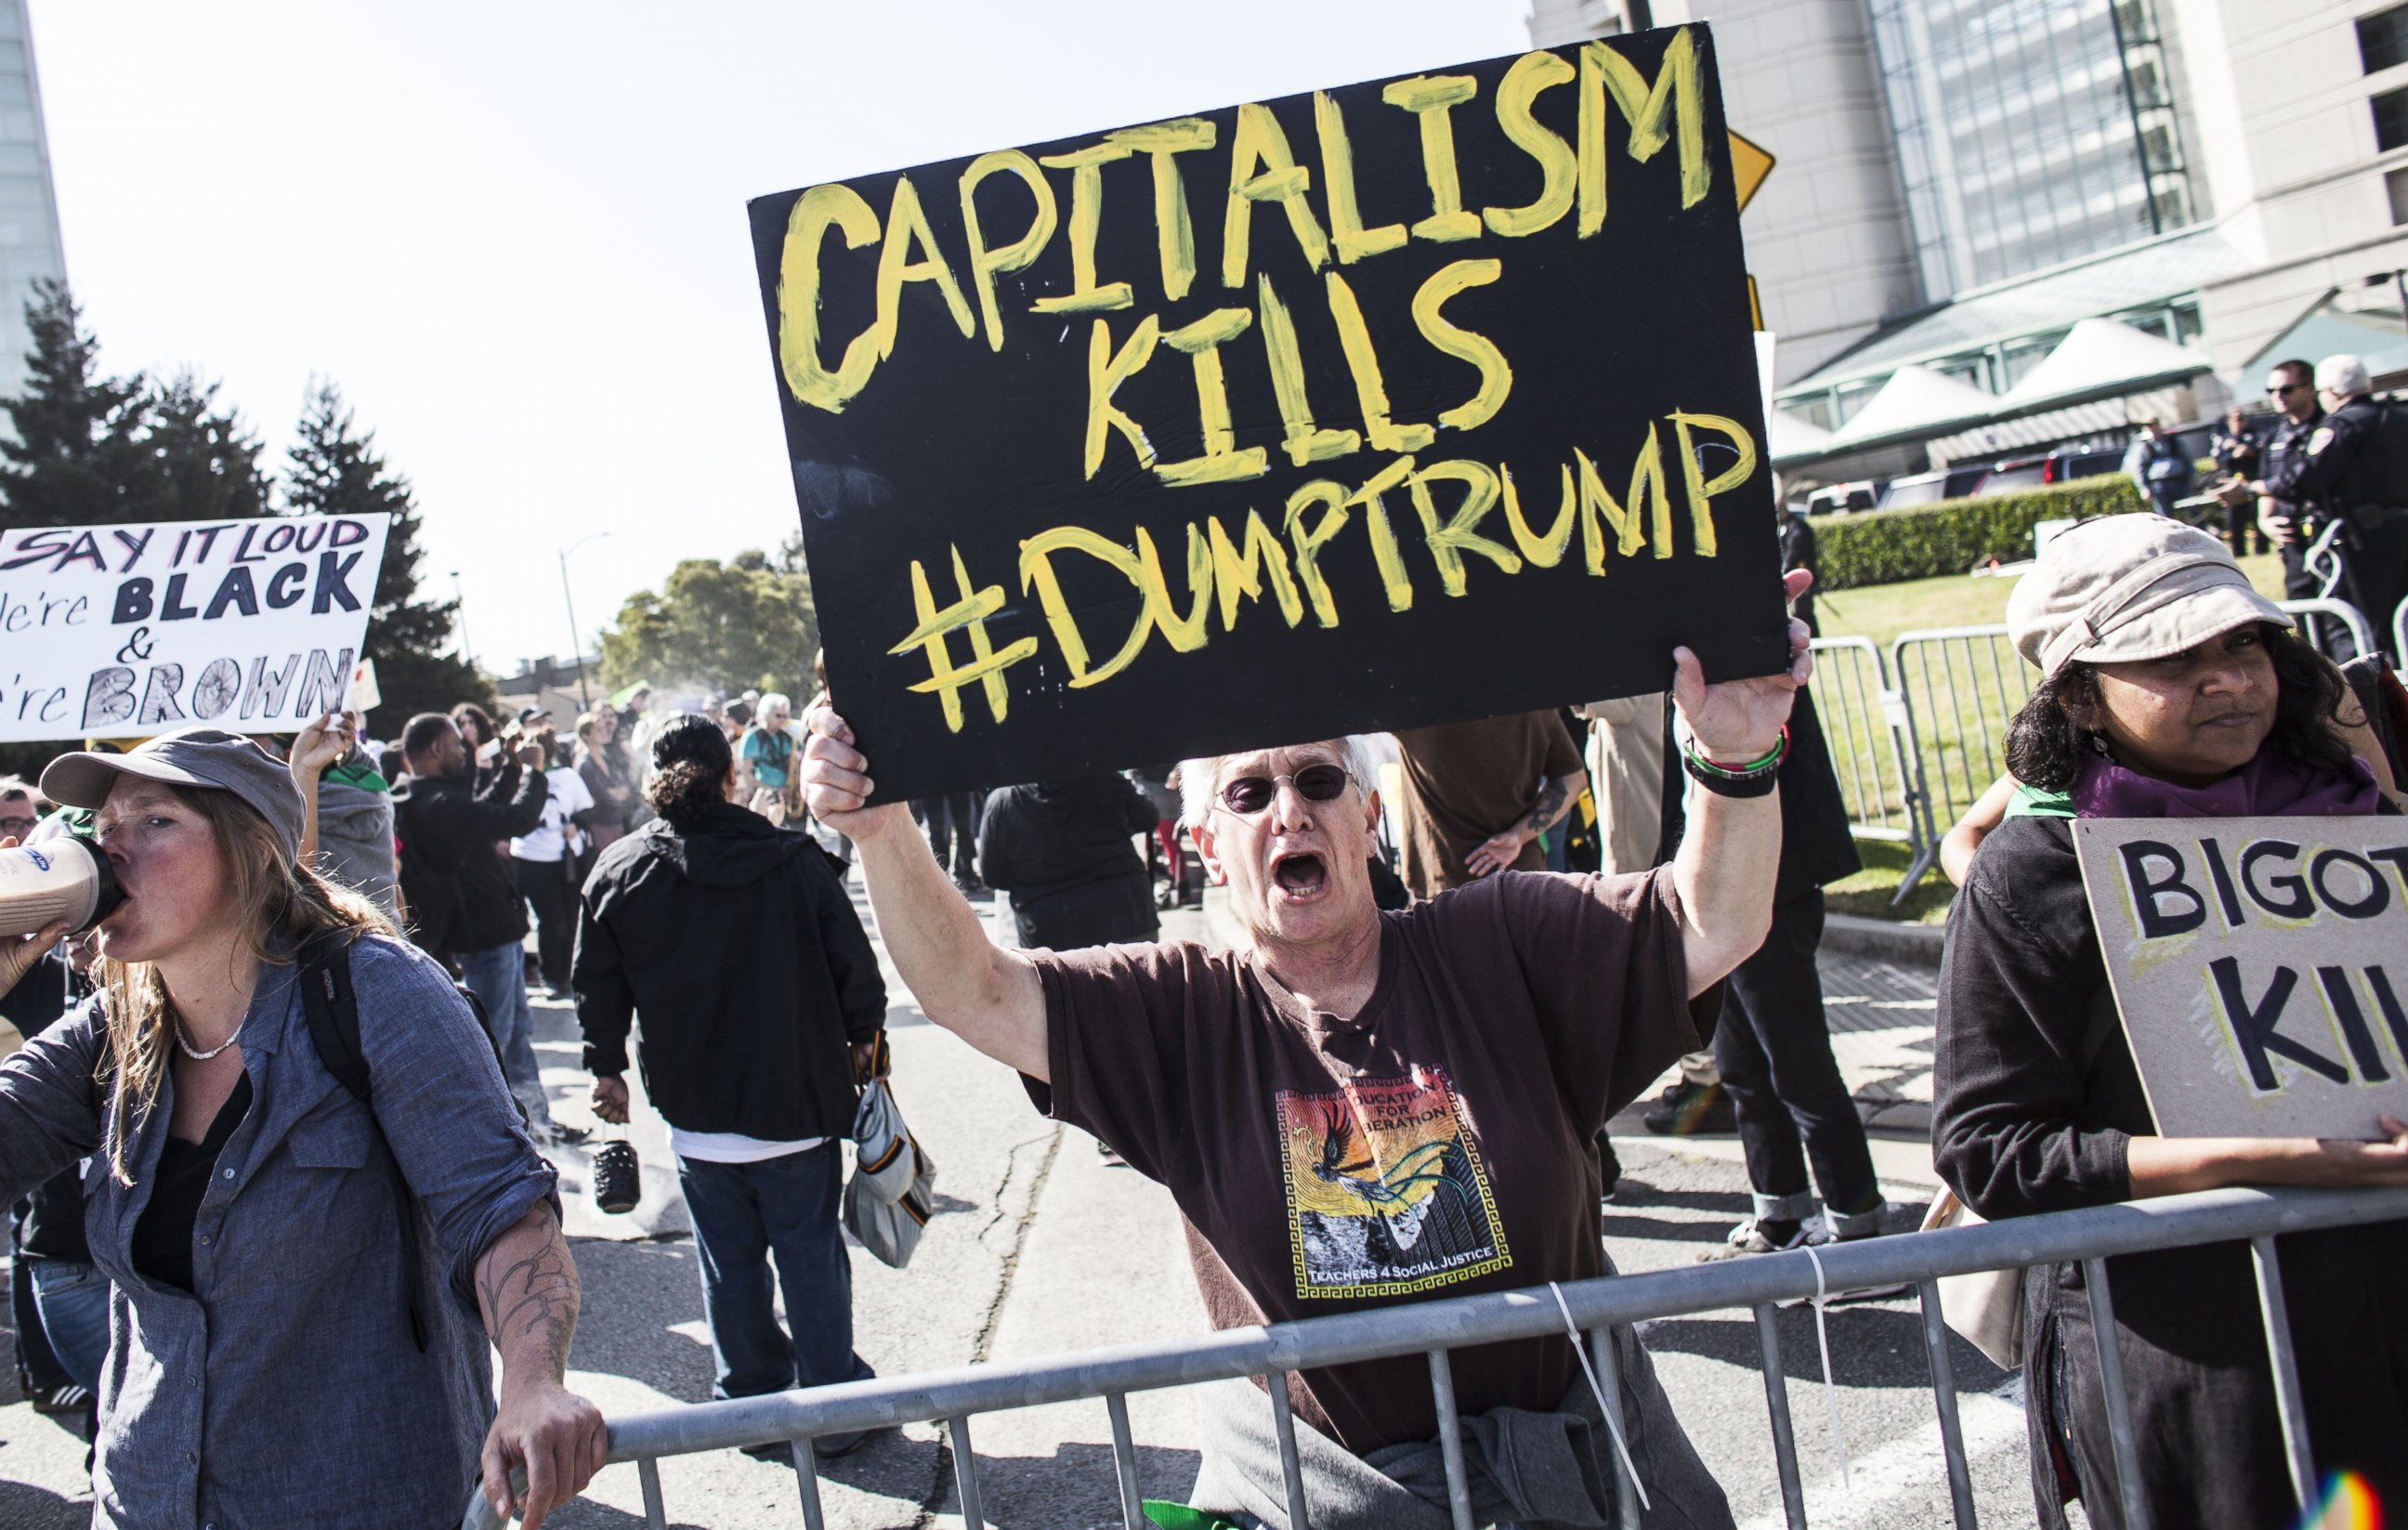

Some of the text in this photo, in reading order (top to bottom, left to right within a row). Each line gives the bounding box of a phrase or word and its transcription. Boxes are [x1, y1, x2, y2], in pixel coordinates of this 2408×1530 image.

[778, 25, 1710, 414] CAPITALISM
[1085, 258, 1512, 488] KILLS
[0, 519, 369, 574] SAY IT LOUD
[887, 410, 1757, 733] #DUMPTRUMP
[111, 551, 364, 624] BLACK
[116, 626, 160, 663] &
[81, 648, 354, 730] BROWN
[1354, 1081, 1437, 1105] DUCATION
[1376, 1105, 1410, 1117] FOR
[1308, 1247, 1493, 1283] TEACHERS 4 SOCIAL JUSTICE
